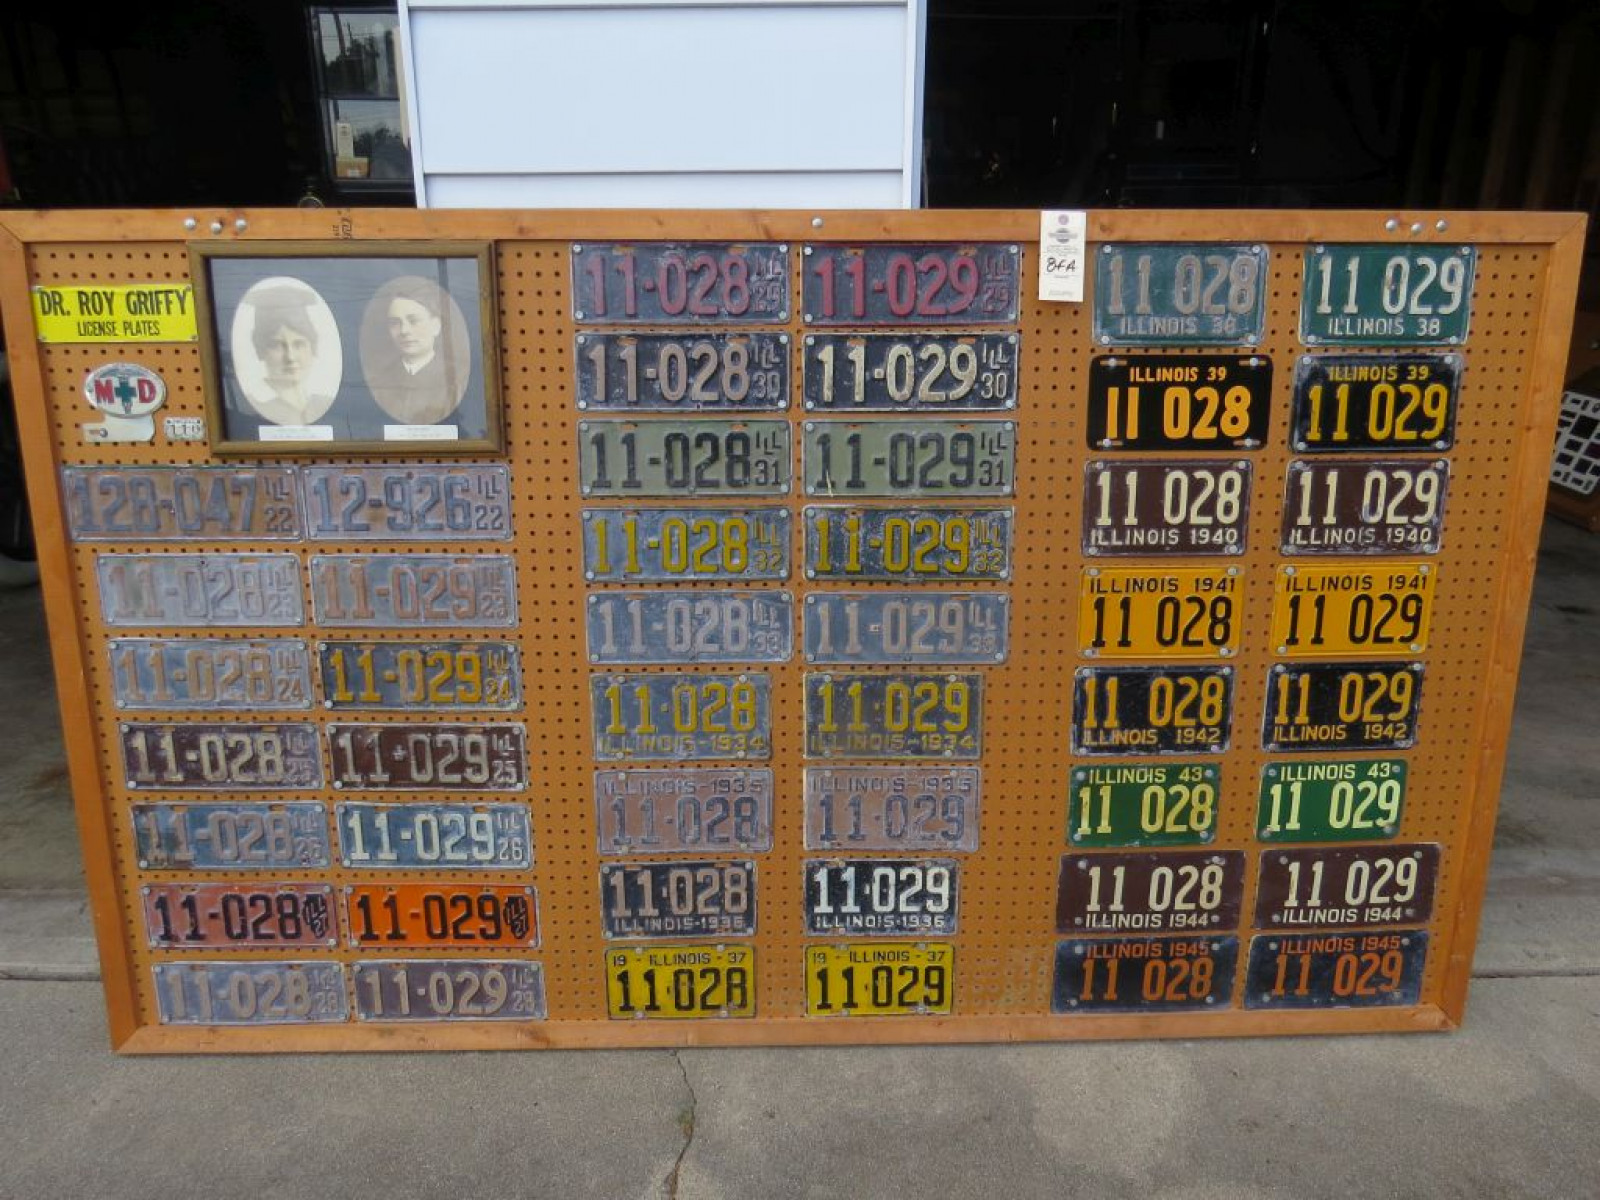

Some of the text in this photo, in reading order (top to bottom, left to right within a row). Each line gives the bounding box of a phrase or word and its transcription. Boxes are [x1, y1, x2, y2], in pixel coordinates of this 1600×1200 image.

[1108, 256, 1258, 314] 11 028
[1317, 256, 1465, 315] 11 029
[39, 289, 186, 316] DR. ROY GRIFFY
[78, 320, 159, 336] LICENSE PLATES
[1120, 316, 1196, 335] ILLINOIS
[1329, 318, 1440, 336] ILLINOIS 38
[1130, 367, 1226, 382] ILLINOIS 39
[1329, 366, 1429, 382] ILLINOIS 39
[1106, 386, 1250, 439] 11 028
[1306, 384, 1448, 441] 11 029
[1096, 470, 1241, 525] 11 028
[1297, 471, 1439, 525] 11 029
[1091, 528, 1238, 545] ILLINOIS 1940
[1291, 528, 1431, 544] ILLINOIS 1940
[1090, 577, 1235, 593] ILLINOIS 1941
[1286, 575, 1426, 591] ILLINOIS 1941
[1092, 596, 1232, 648] 11 028
[1286, 593, 1423, 645] 11 029
[1083, 677, 1224, 728] 11 028
[1275, 672, 1413, 724] 11 029
[1084, 728, 1220, 745] ILLINOIS 1942
[1274, 724, 1407, 741] ILLINOIS 1942
[1089, 768, 1202, 784] ILLINOIS 43
[1281, 763, 1390, 781] ILLINOIS 43
[1078, 785, 1214, 835] 11 028
[1268, 780, 1400, 832] 11 029
[1087, 865, 1223, 912] 11 028
[1284, 858, 1418, 908] 11 029
[1085, 913, 1208, 928] ILLINOIS 1944
[1282, 908, 1401, 924] ILLINOIS 1944
[1087, 942, 1208, 959] ILLINOIS 1945
[1282, 937, 1400, 954] ILLINOIS 1945
[613, 952, 746, 965] 19 ILLINOIS 37
[813, 950, 945, 963] 19 ILLINOIS 37
[1079, 959, 1213, 1001] 11 028
[1272, 952, 1403, 997] 11 029
